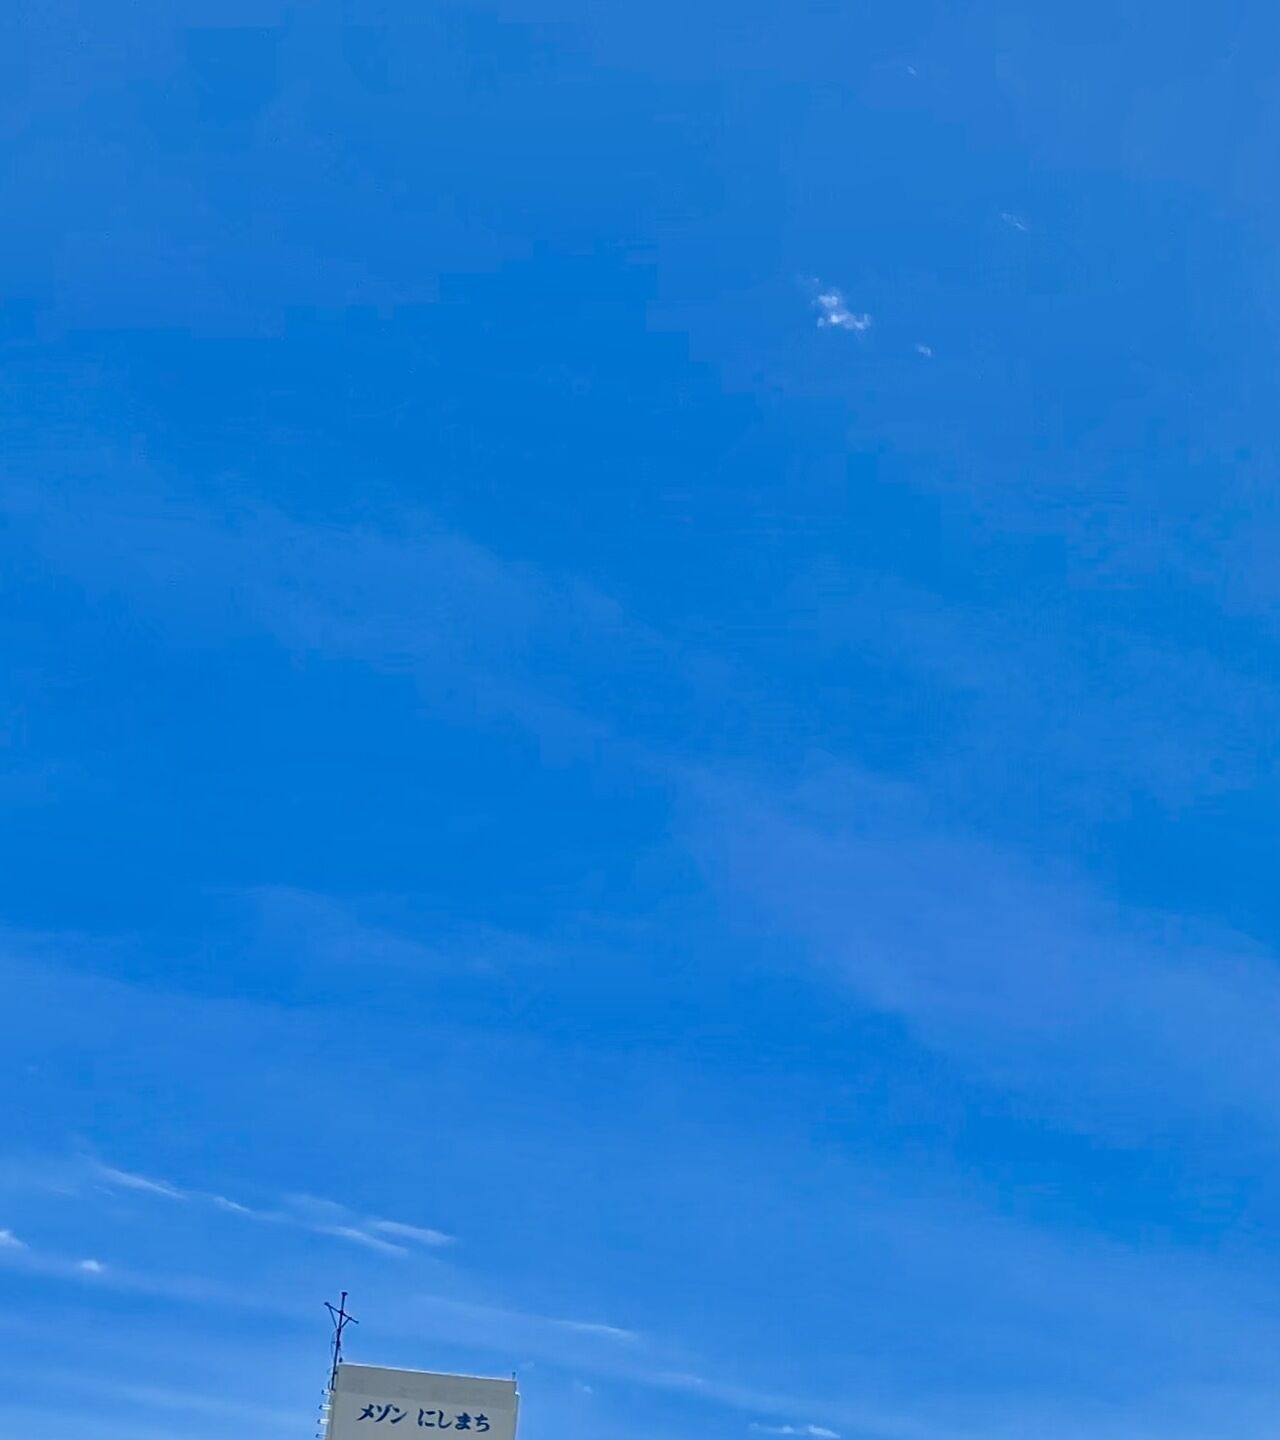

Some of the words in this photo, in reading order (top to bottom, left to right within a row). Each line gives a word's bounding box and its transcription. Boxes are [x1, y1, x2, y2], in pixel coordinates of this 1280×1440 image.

[356, 1403, 409, 1425] メゾン
[417, 1407, 491, 1433] にしまち
